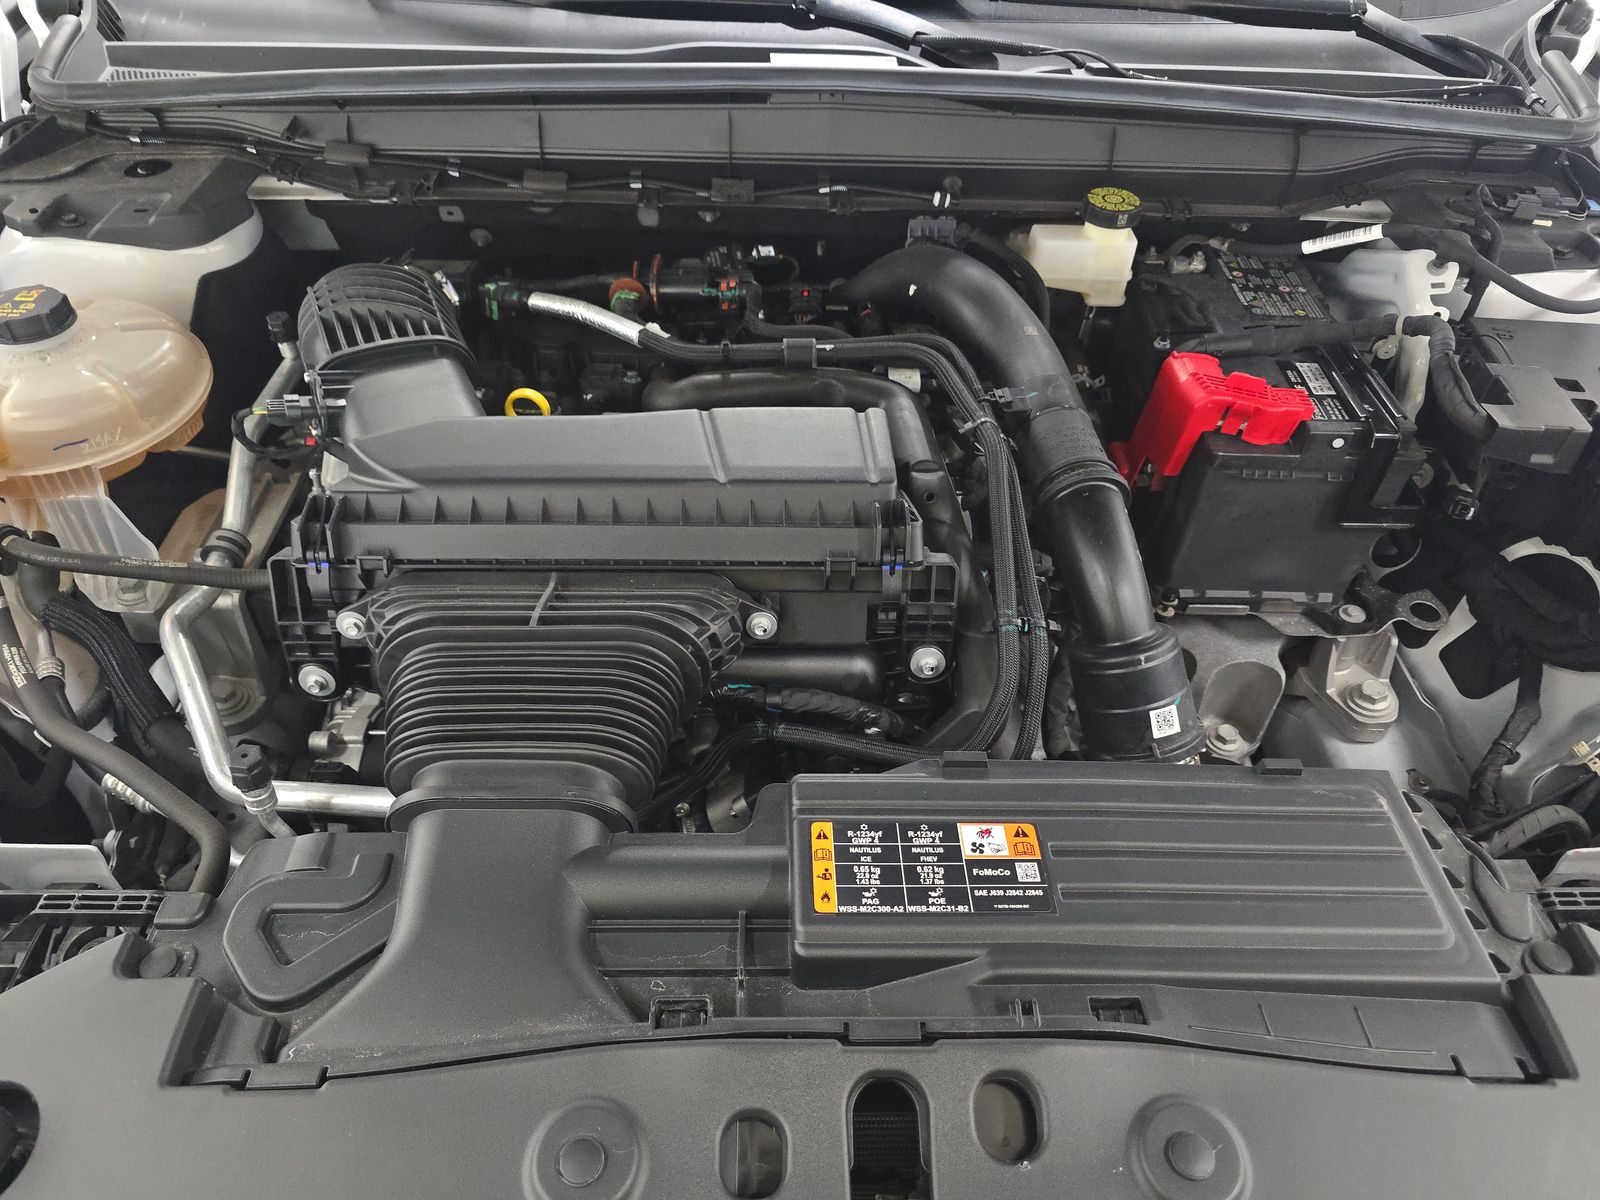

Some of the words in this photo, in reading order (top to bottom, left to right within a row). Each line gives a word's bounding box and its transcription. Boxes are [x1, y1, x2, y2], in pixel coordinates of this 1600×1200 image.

[871, 866, 881, 875] kg
[934, 866, 944, 875] kg
[838, 905, 904, 913] WSS-M2C300-A2
[907, 905, 969, 913] WSS-M2C31-B2
